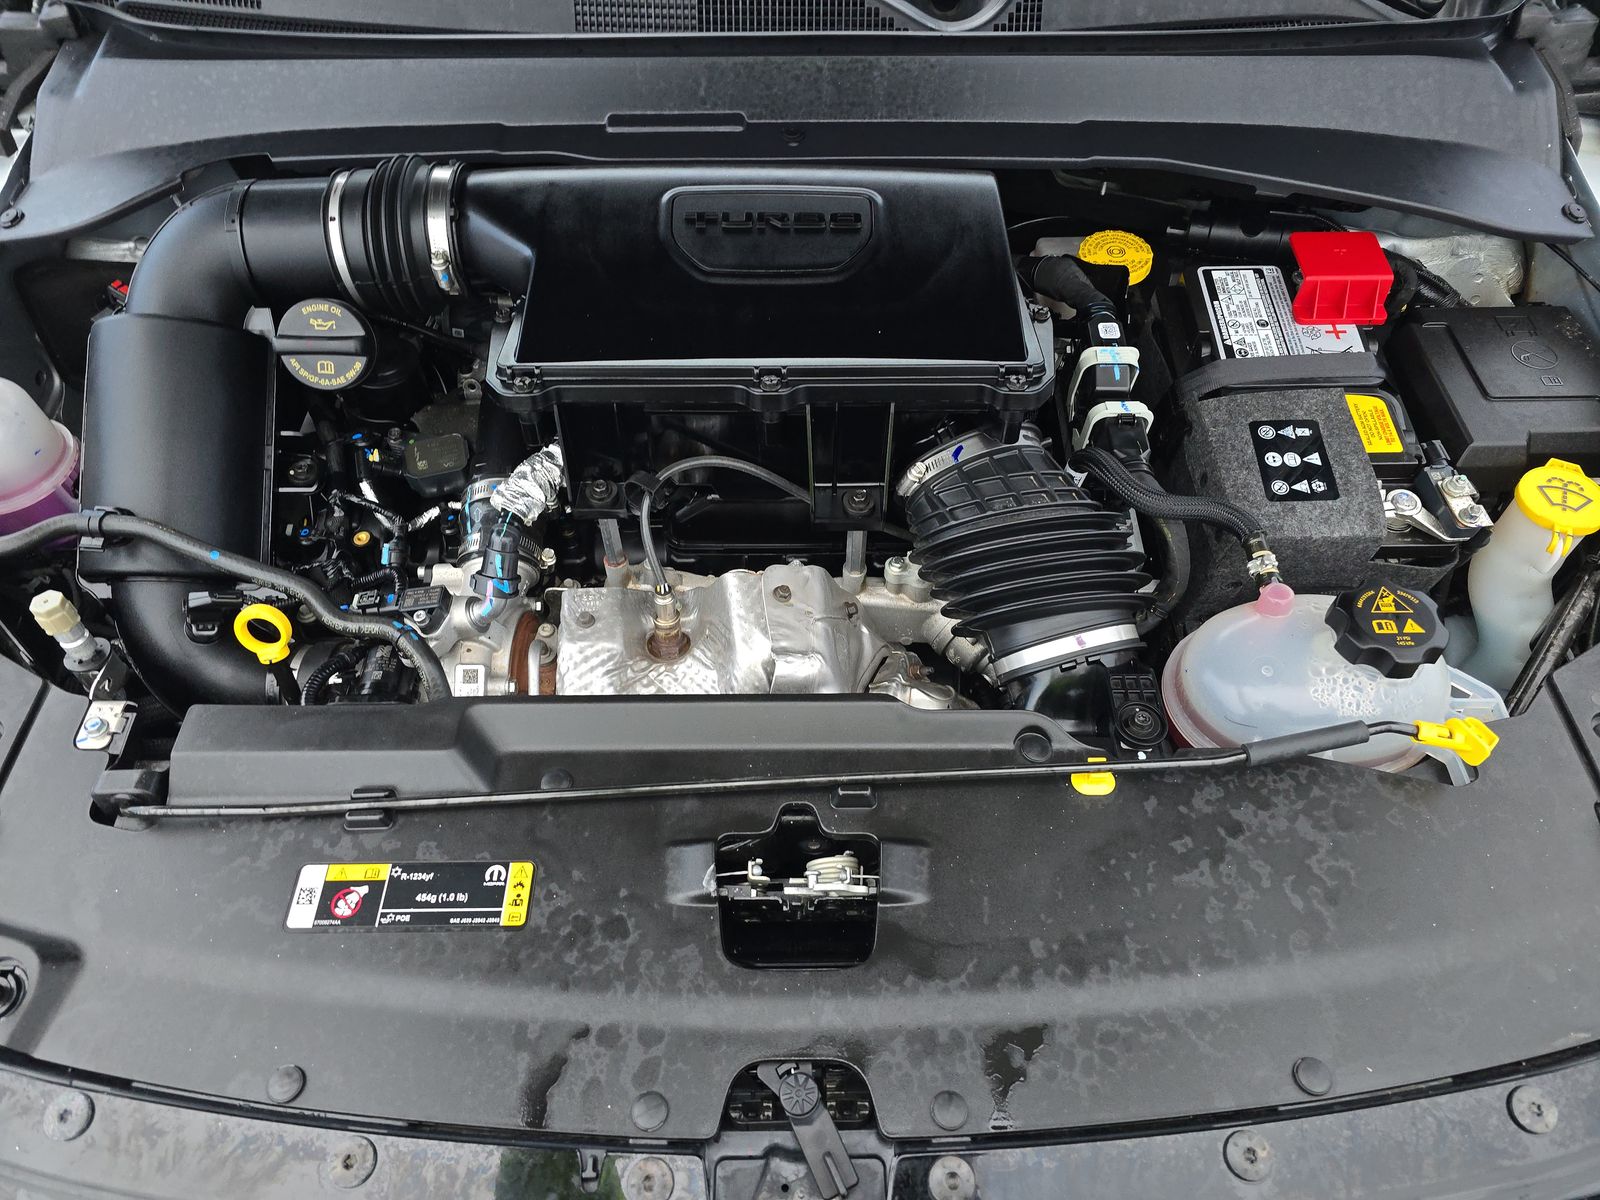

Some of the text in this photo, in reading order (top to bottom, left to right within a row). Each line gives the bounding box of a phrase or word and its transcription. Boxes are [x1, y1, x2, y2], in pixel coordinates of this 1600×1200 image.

[684, 211, 862, 230] TURBO
[301, 303, 342, 317] ENGINE OIL
[289, 358, 301, 371] API
[400, 872, 434, 882] R-1234yf
[415, 892, 468, 904] 454g (1.0 lb)
